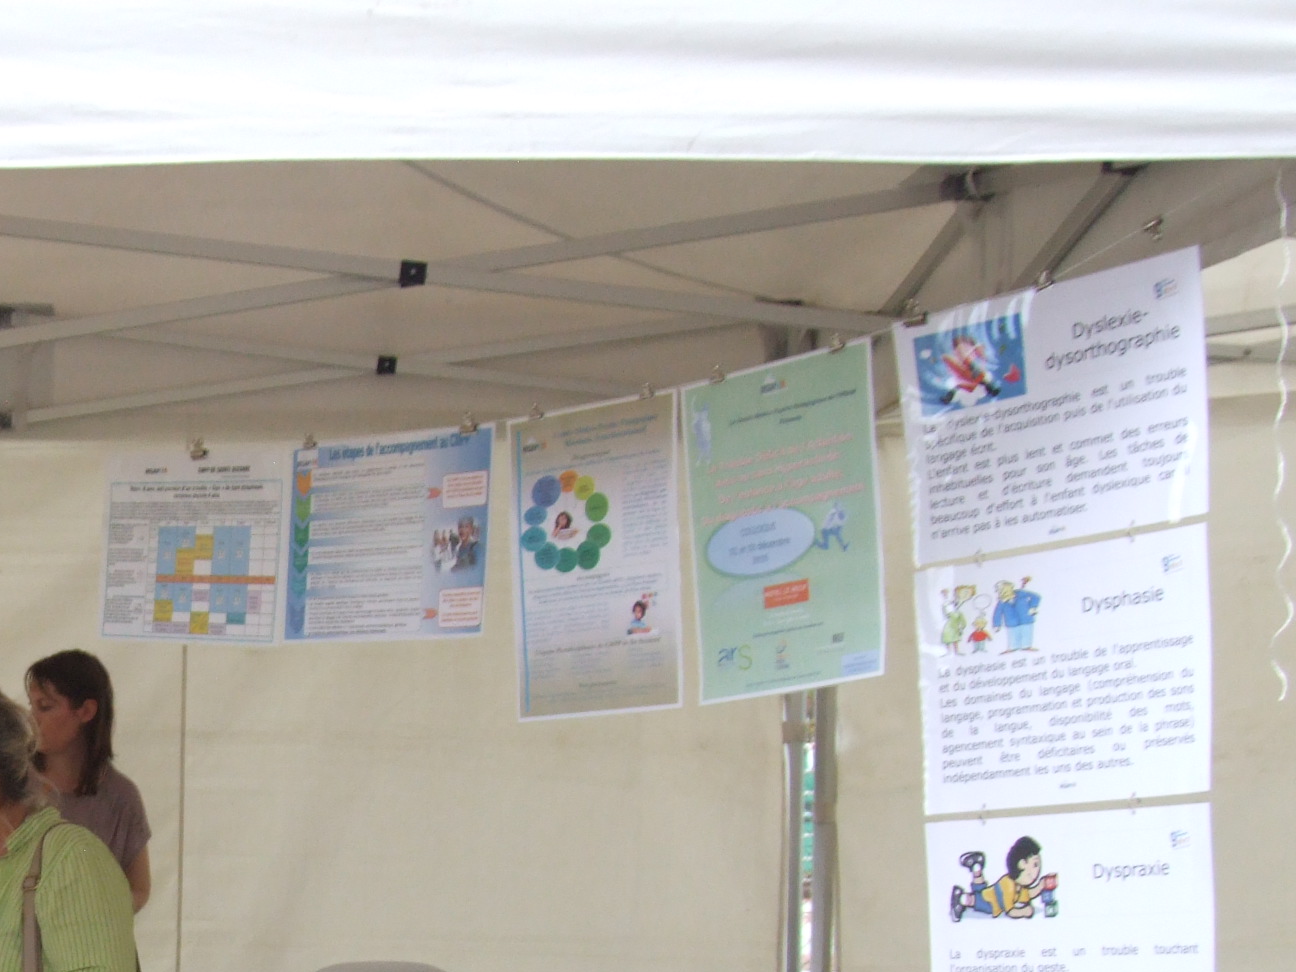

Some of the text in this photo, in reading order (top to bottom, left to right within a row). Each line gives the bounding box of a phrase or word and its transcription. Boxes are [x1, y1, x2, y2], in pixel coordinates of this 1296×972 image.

[1072, 308, 1149, 340] Dyslexie-
[1044, 324, 1180, 370] dysorthographie
[1082, 586, 1164, 616] Dysphasie
[1093, 861, 1170, 883] Dyspraxie
[948, 944, 1198, 960] La dyspraxie est un trouble touchant
[1020, 962, 1034, 972] du
